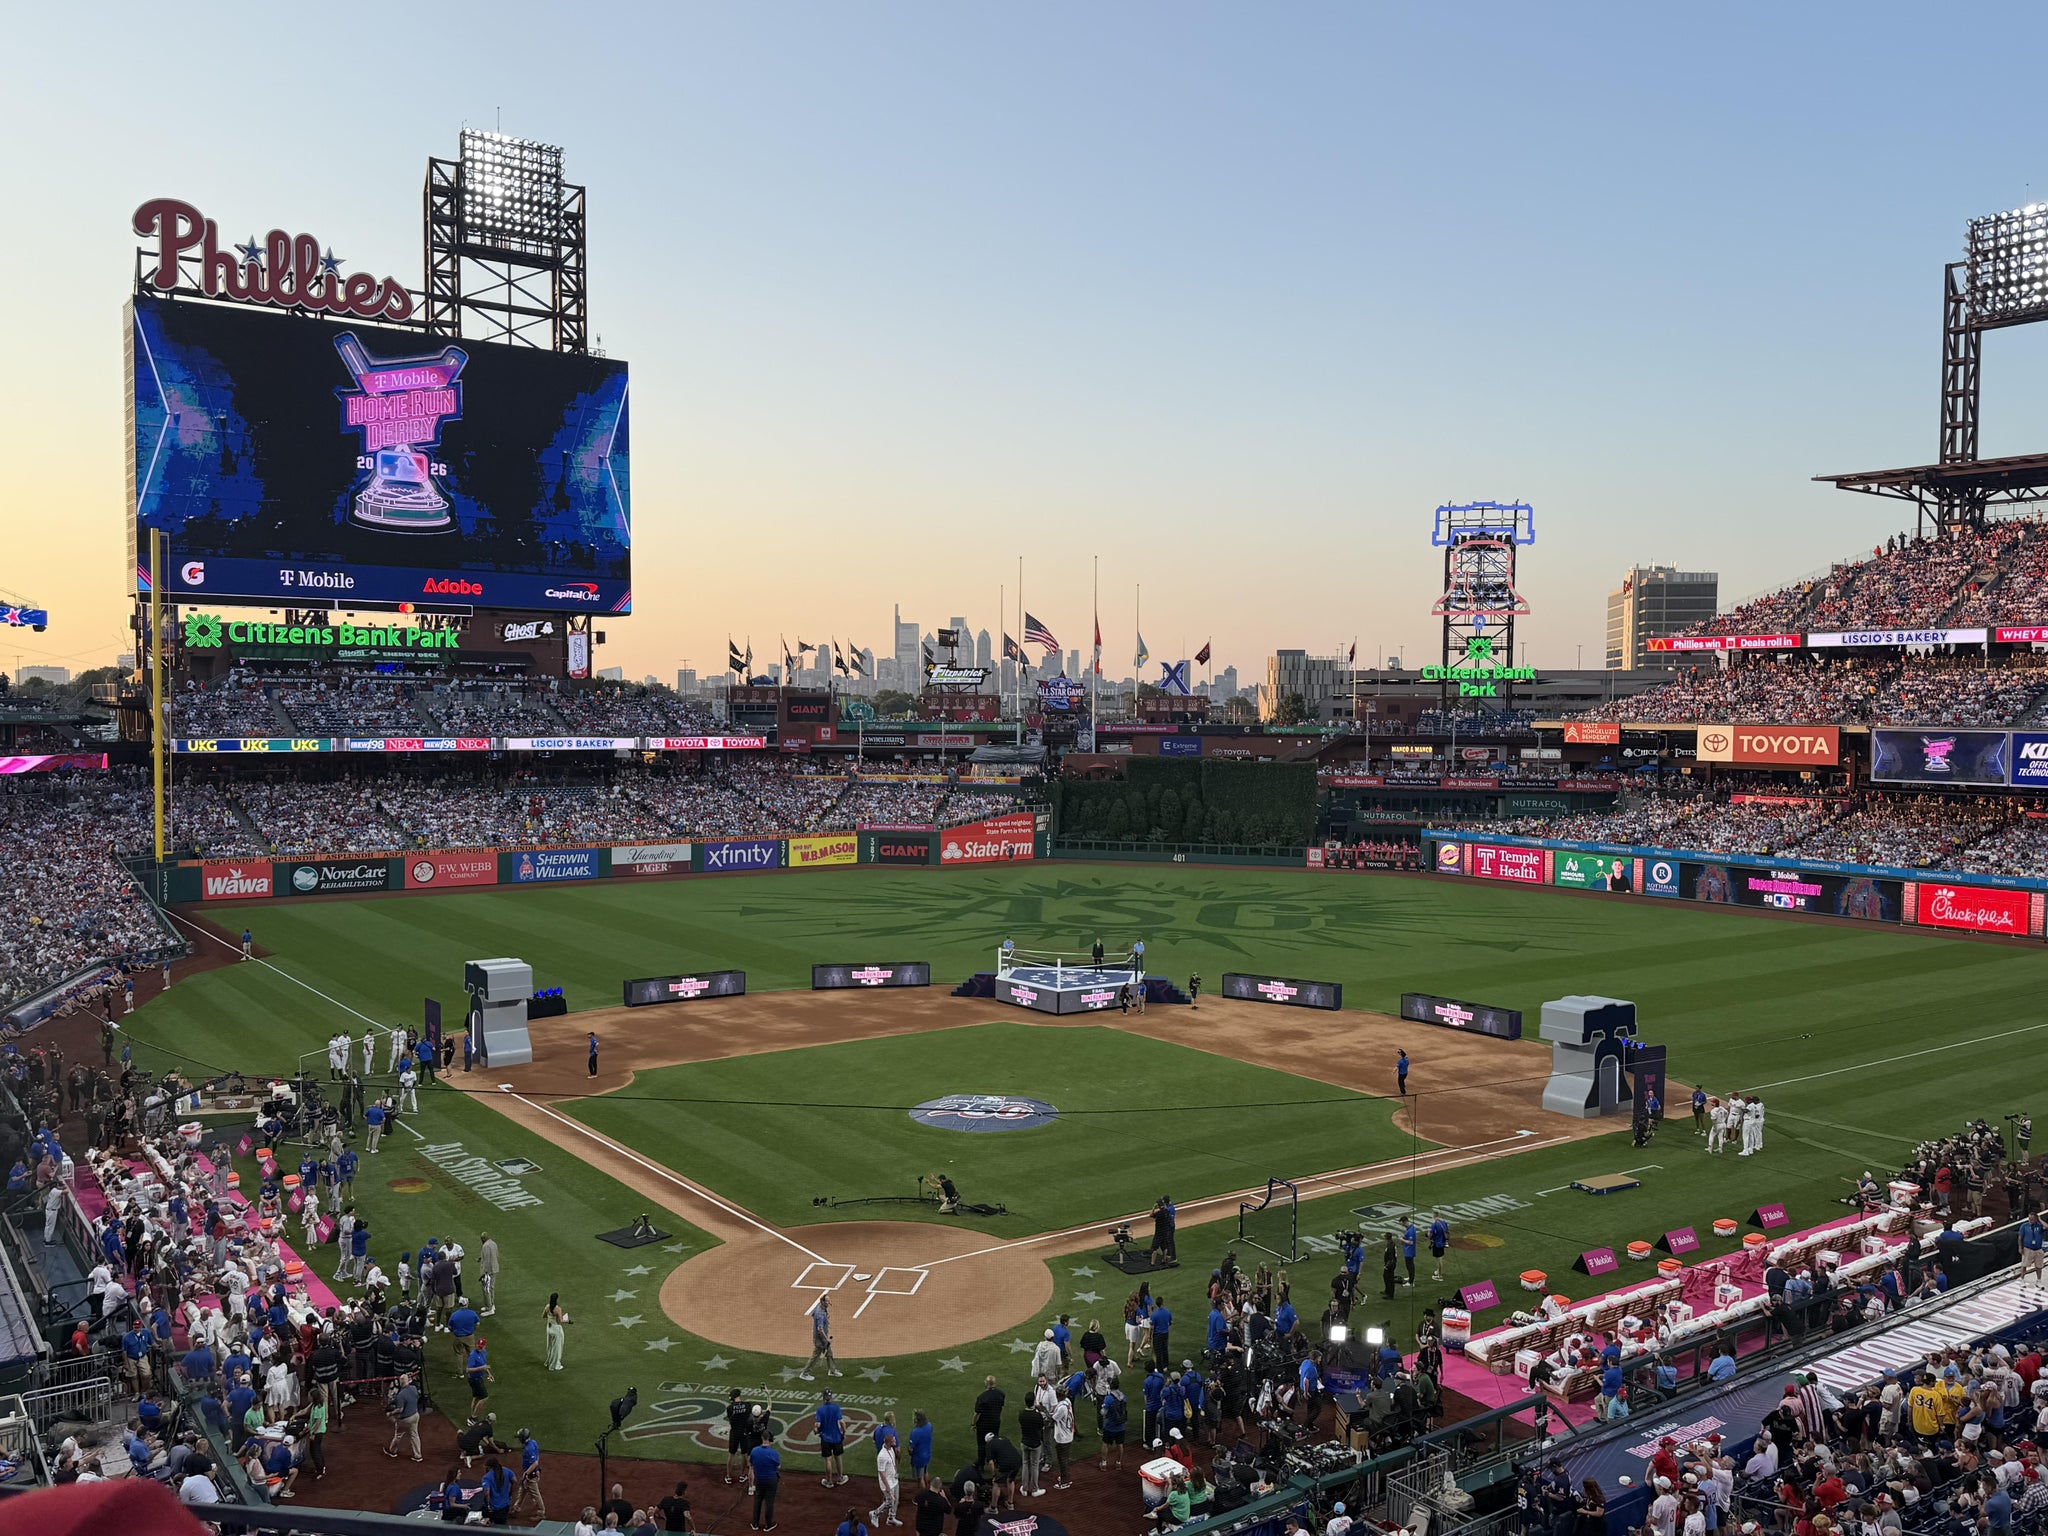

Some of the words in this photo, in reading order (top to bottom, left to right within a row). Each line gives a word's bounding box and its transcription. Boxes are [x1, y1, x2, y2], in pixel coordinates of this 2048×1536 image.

[132, 196, 414, 322] Phillies
[390, 370, 438, 386] Mobile
[346, 392, 410, 424] HOME
[409, 388, 456, 418] RUN
[366, 416, 438, 452] DERBY
[356, 456, 374, 470] 20
[430, 462, 448, 476] 26
[297, 570, 354, 588] Mobile
[422, 577, 482, 596] Adobe
[228, 620, 334, 644] Citizens
[338, 624, 400, 648] Bank
[406, 628, 460, 649] Park
[1842, 631, 1893, 646] LISCIO'S
[1896, 629, 1948, 643] BAKERY
[2002, 630, 2039, 640] WHEY
[1672, 639, 1702, 650] Phillies
[1704, 638, 1720, 650] win
[1740, 637, 1761, 648] Deals
[1763, 636, 1780, 647] roll
[1782, 636, 1792, 646] in
[1422, 664, 1490, 680] Citizens
[1493, 664, 1536, 680] Bank
[1037, 686, 1050, 696] ALL
[1050, 687, 1067, 696] STAR
[1066, 688, 1085, 696] GAME
[1459, 682, 1498, 697] Park
[790, 705, 825, 714] GIANT
[188, 740, 218, 751] UKG
[240, 740, 269, 751] UKG
[291, 740, 320, 751] UKG
[389, 740, 419, 749] NECA
[459, 739, 490, 749] NECA
[531, 739, 574, 748] LISCIO'S
[576, 738, 615, 748] BAKERY
[668, 738, 705, 748] TOYOTA
[726, 738, 761, 747] TOYOTA
[1739, 734, 1830, 754] TOYOTA
[1344, 777, 1378, 785] Budweiser
[1458, 780, 1493, 788] Budweiser
[1576, 781, 1612, 790] Budweiser
[1513, 800, 1563, 808] NUTRAFOL
[1363, 812, 1406, 820] NUTRAFOL
[203, 857, 256, 866] ASPLUNDH
[265, 854, 317, 864] ASPLUNDH
[325, 852, 374, 861] ASPLUNDH
[383, 850, 431, 858] ASPLUNDH
[438, 847, 486, 856] ASPLUNDH
[545, 843, 587, 851] ASPLUNDH
[688, 836, 726, 844] ASPLUNDH
[732, 835, 770, 843] ASPLUNDH
[626, 845, 677, 864] Yuengling
[708, 844, 773, 867] xfinity
[879, 845, 928, 857] GIANT
[1172, 853, 1186, 863] 401
[1499, 850, 1540, 866] Temple
[536, 852, 590, 866] SHERWIN
[320, 864, 387, 881] NovaCare
[460, 862, 492, 873] WEBB
[635, 863, 668, 873] LAGER
[1499, 864, 1537, 880] Health
[1800, 862, 1835, 870] Independence
[1866, 866, 1889, 875] ibx.com
[1916, 870, 1954, 880] Independence
[1991, 876, 2016, 886] ibx.com
[1777, 871, 1799, 880] Mobile
[206, 876, 270, 896] Wawa
[320, 879, 384, 890] REHABILITATION
[1764, 894, 1773, 903] 20
[414, 1142, 470, 1164] ALL
[438, 1157, 502, 1186] STAR
[472, 1178, 545, 1212] GAME
[1769, 1208, 1784, 1221] Mobile
[1677, 1232, 1696, 1246] Mobile
[1595, 1253, 1613, 1266] Mobile
[1474, 1288, 1494, 1303] Mobile
[1790, 1312, 1972, 1392] NATIONAL
[1914, 1394, 1934, 1410] 34
[1669, 1509, 1675, 1523] 3
